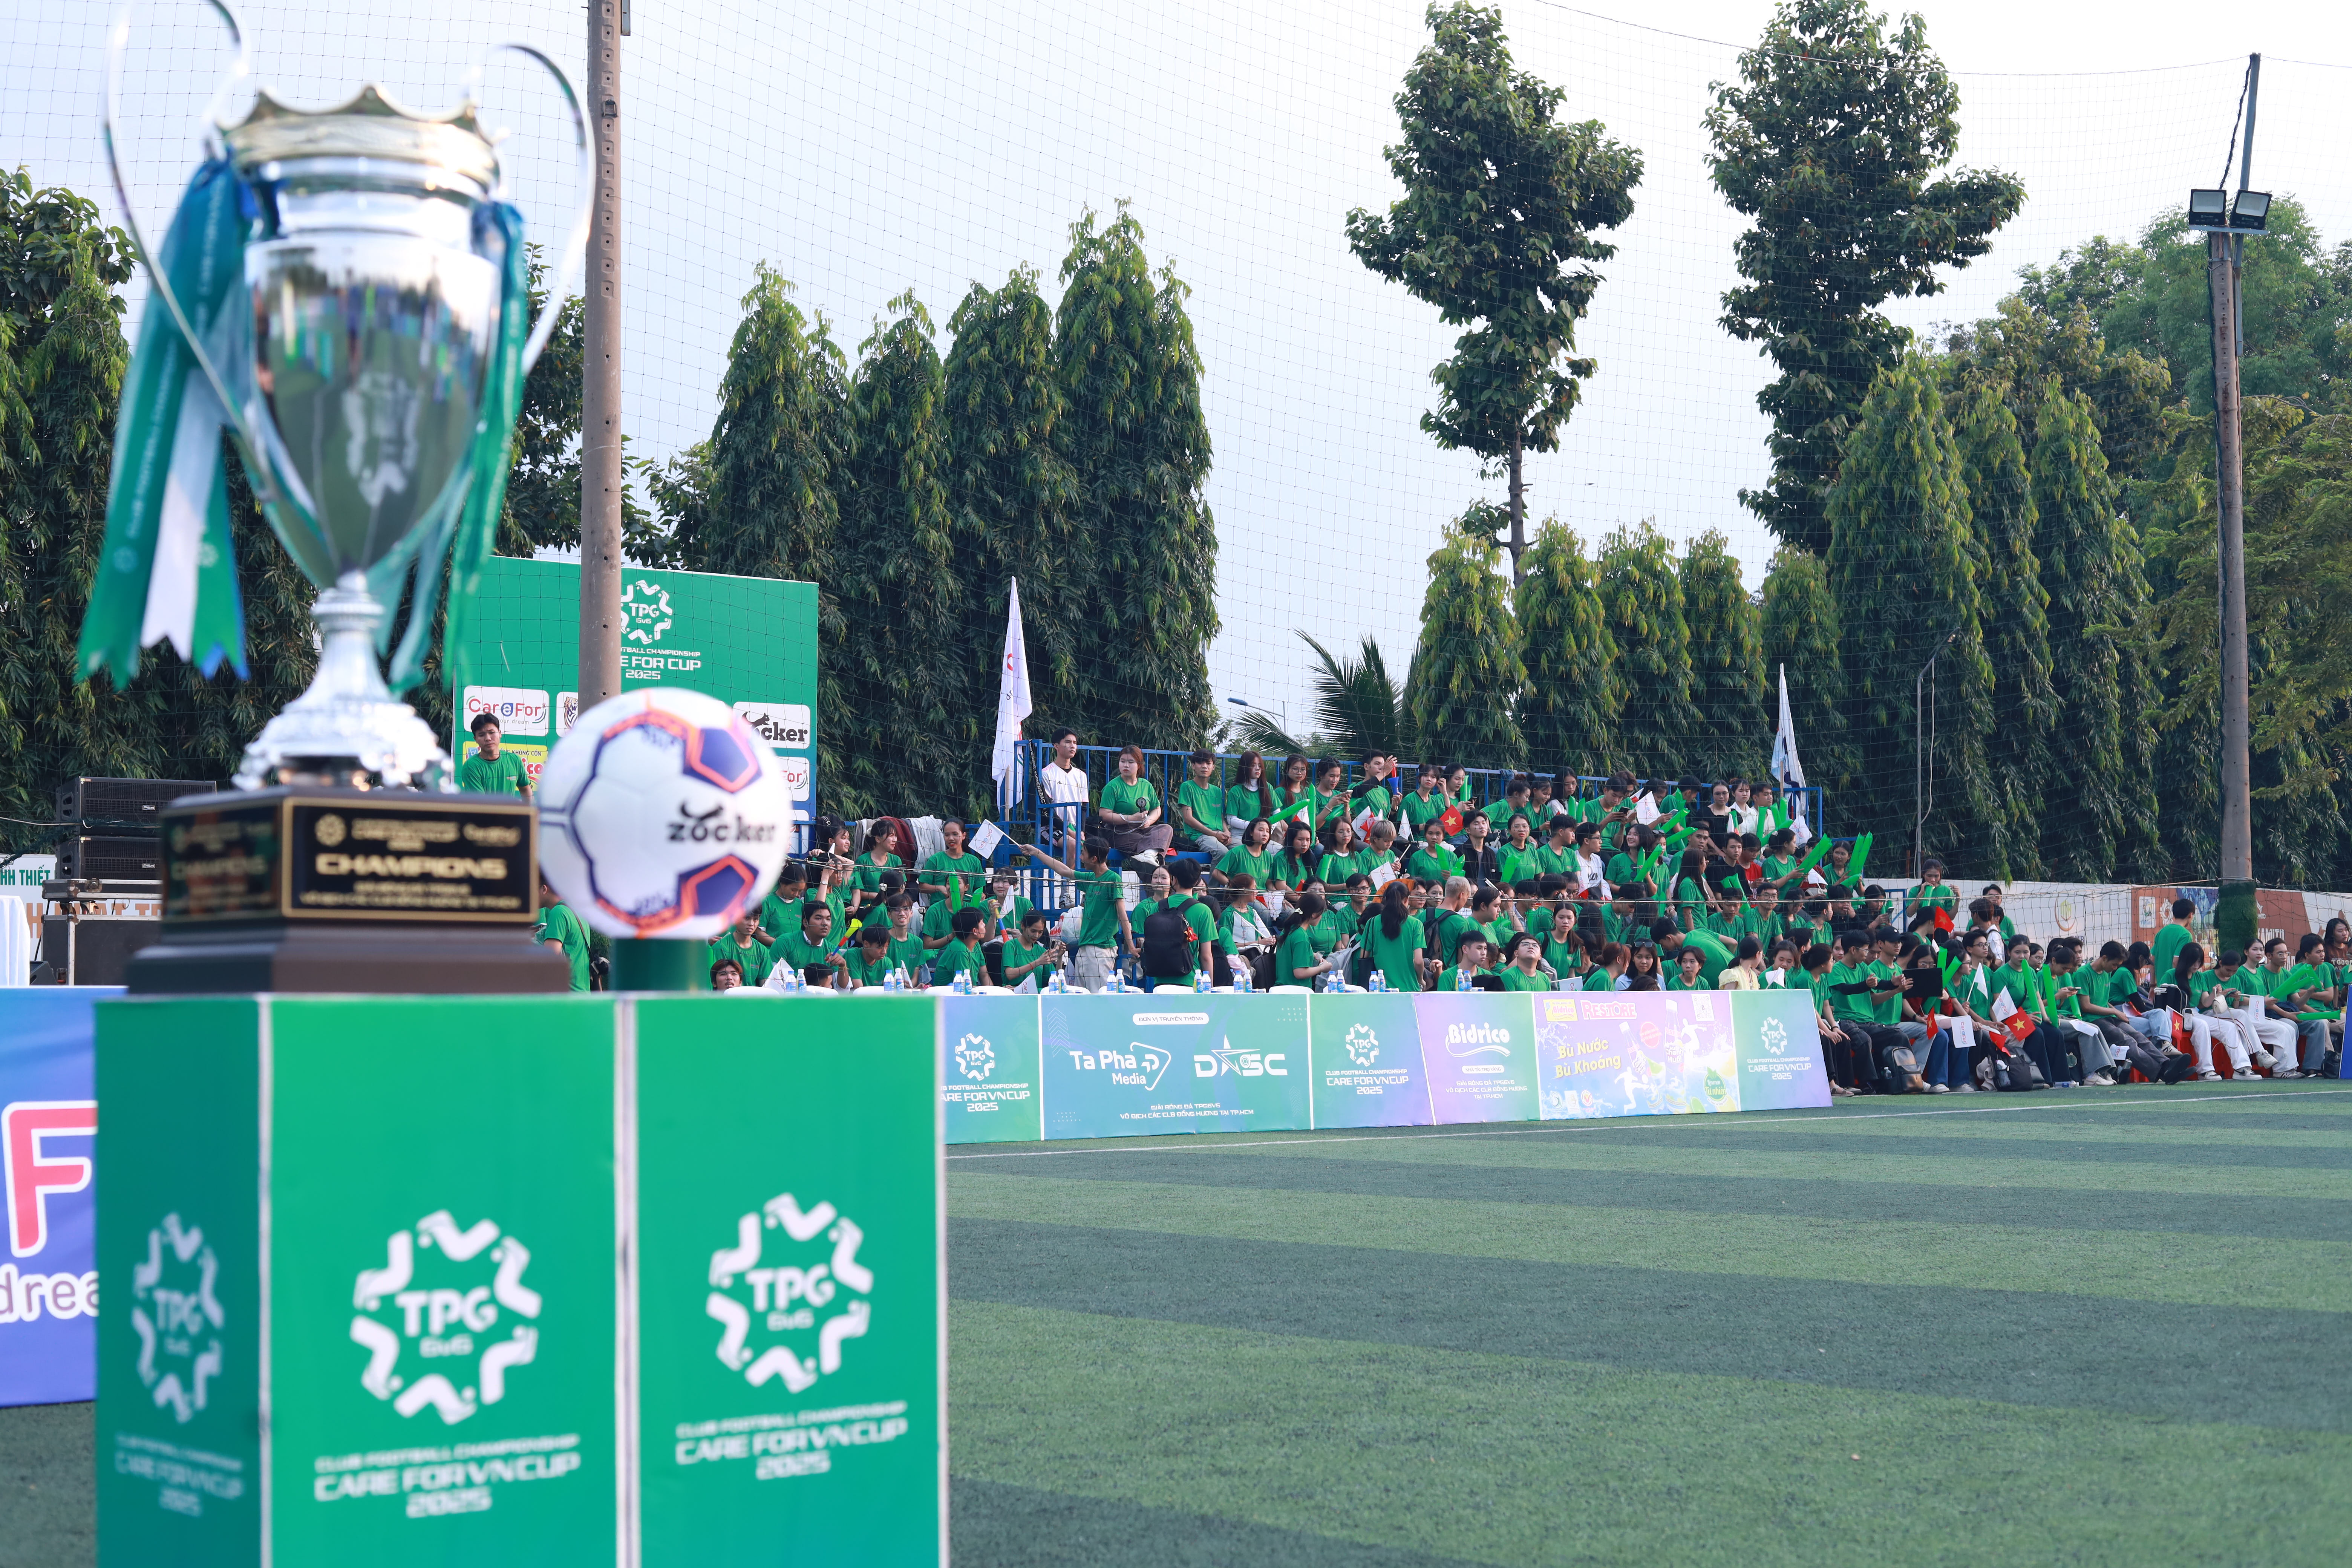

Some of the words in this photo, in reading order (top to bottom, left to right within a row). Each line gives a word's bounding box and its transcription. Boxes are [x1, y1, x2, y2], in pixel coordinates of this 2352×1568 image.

[629, 603, 659, 618] TPG
[646, 648, 701, 657] CHAMPIONSHIP
[632, 656, 664, 669] FOR
[668, 658, 701, 671] CUP
[625, 669, 661, 680] 2025
[315, 853, 507, 879] CHAMPIONS
[1581, 1001, 1637, 1020] RESTORE
[1448, 1022, 1510, 1044] Bidrico
[1352, 1039, 1371, 1049] TPG
[1557, 1043, 1574, 1059] Bù
[1577, 1037, 1609, 1056] Nước
[963, 1050, 986, 1061] TPG
[1069, 1051, 1096, 1070] Ta
[1099, 1050, 1137, 1069] Pha
[1554, 1062, 1571, 1078] Bù
[1573, 1054, 1621, 1075] Khoáng
[1112, 1073, 1146, 1085] Media
[1326, 1077, 1352, 1086] CARE
[940, 1093, 962, 1102] ARE
[1356, 1086, 1383, 1094] 2025
[966, 1102, 998, 1112] 2025
[745, 1263, 836, 1312] TPG
[395, 1285, 498, 1337] TPG
[675, 1434, 750, 1465] CARE
[755, 1449, 831, 1481] 2025
[314, 1468, 400, 1502] CARE
[406, 1485, 493, 1518] 2025
